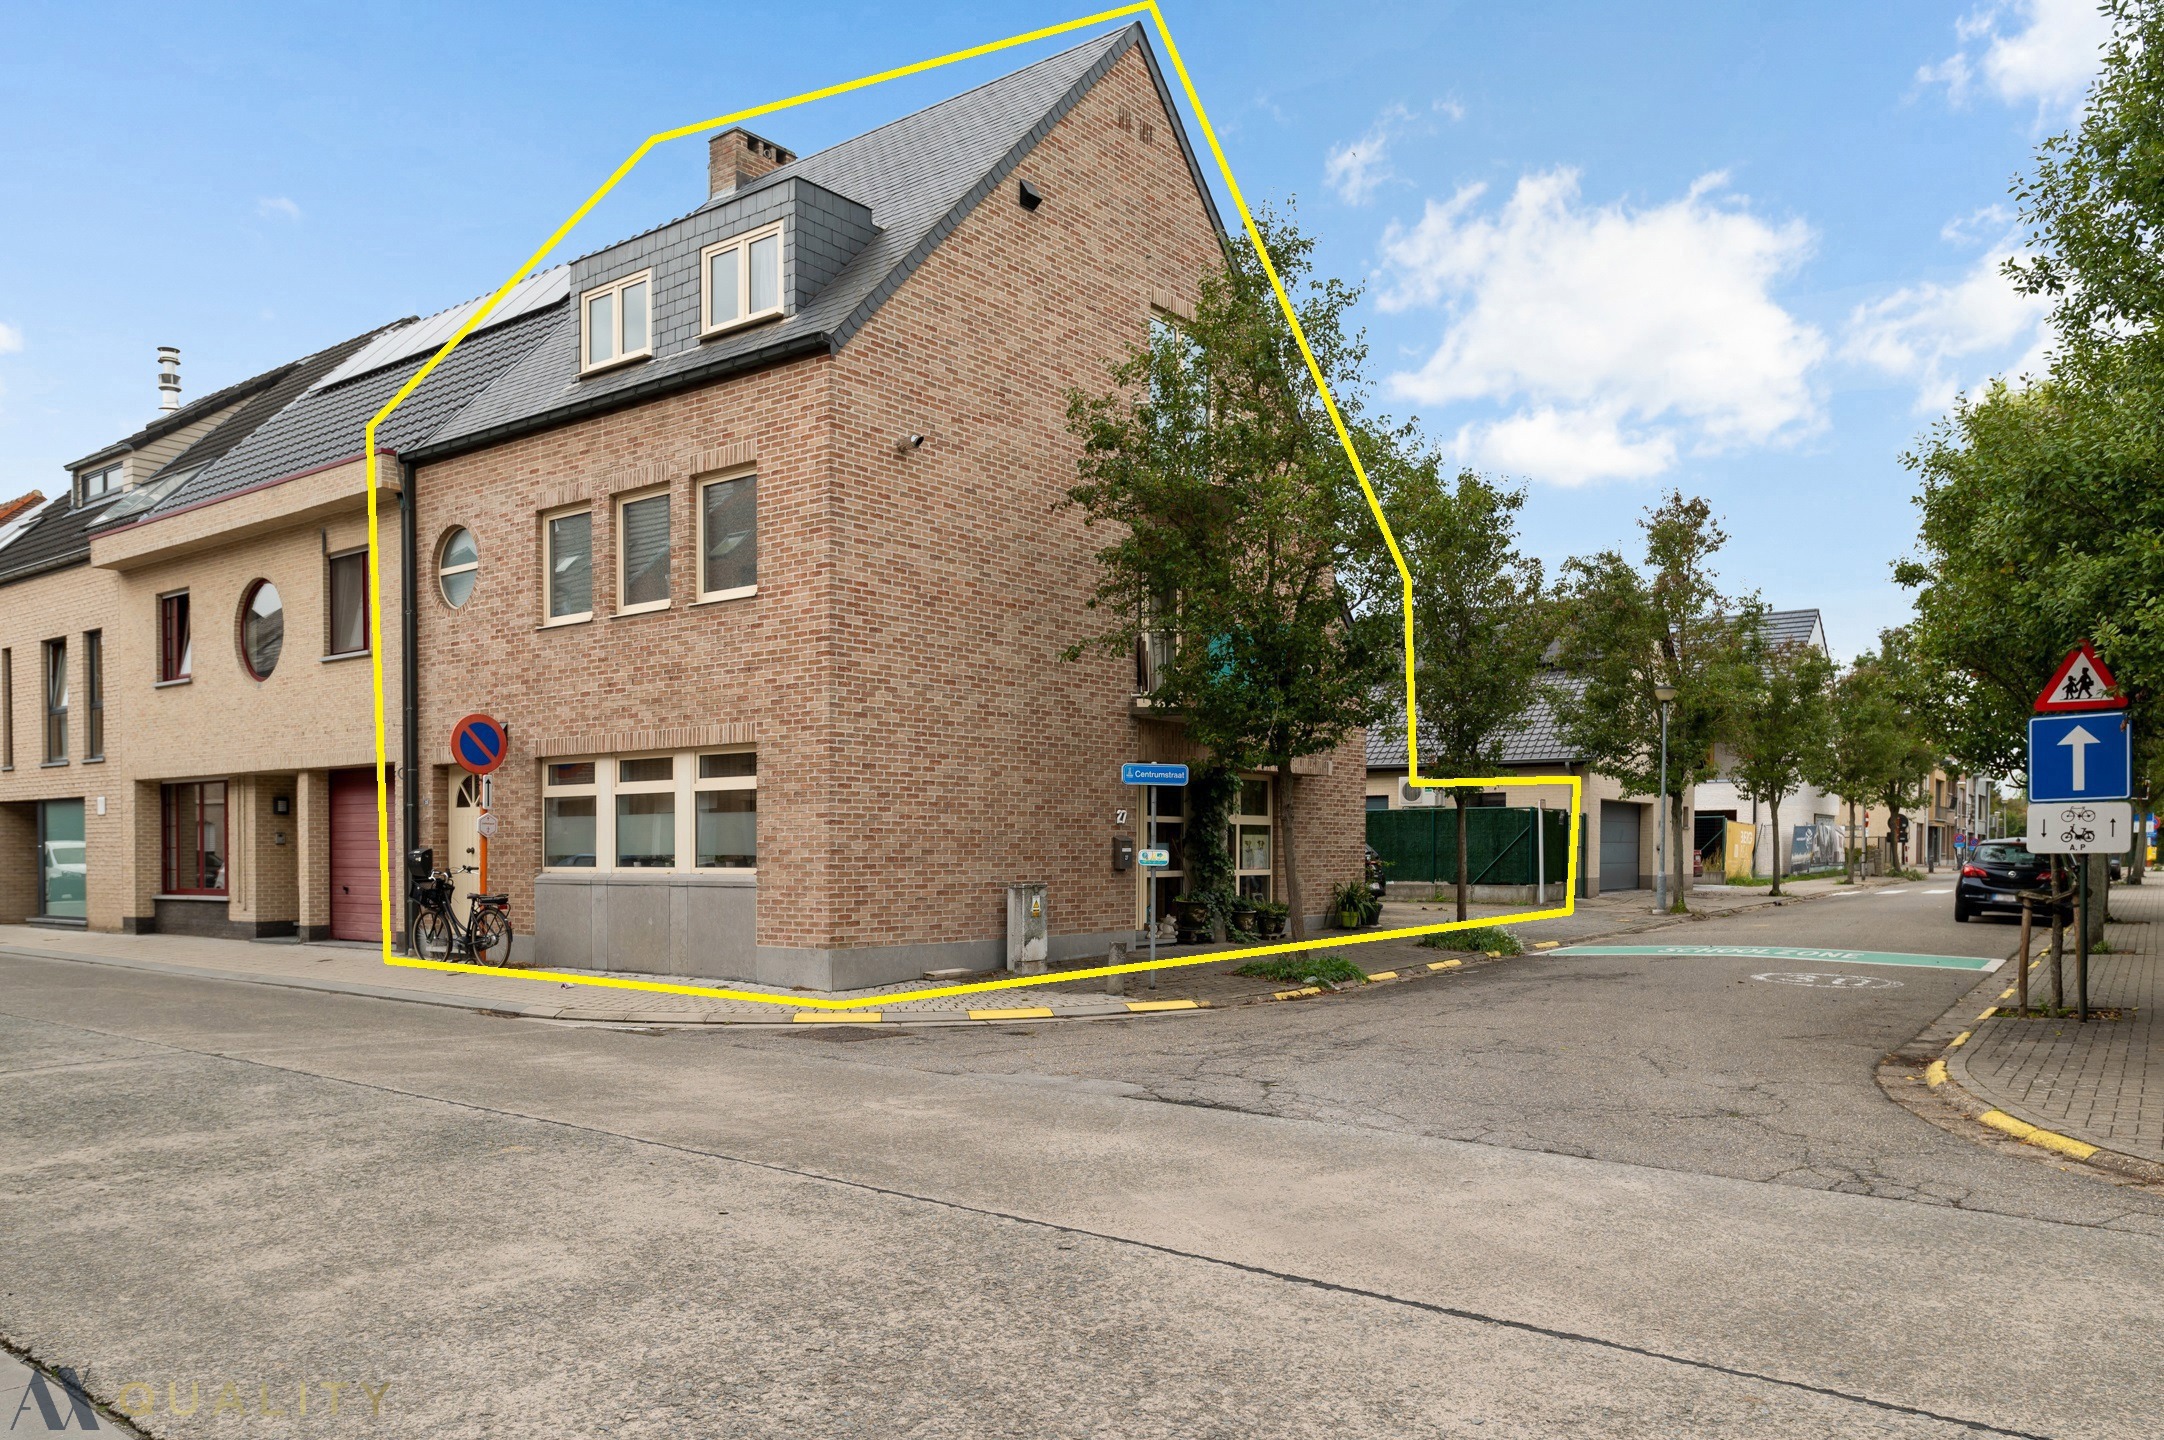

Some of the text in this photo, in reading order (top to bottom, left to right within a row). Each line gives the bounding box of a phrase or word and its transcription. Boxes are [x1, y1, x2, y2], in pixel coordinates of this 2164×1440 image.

[1134, 770, 1185, 779] Centrumstraat
[1116, 809, 1127, 824] 27
[1657, 947, 1865, 960] SCHOOL ZONE
